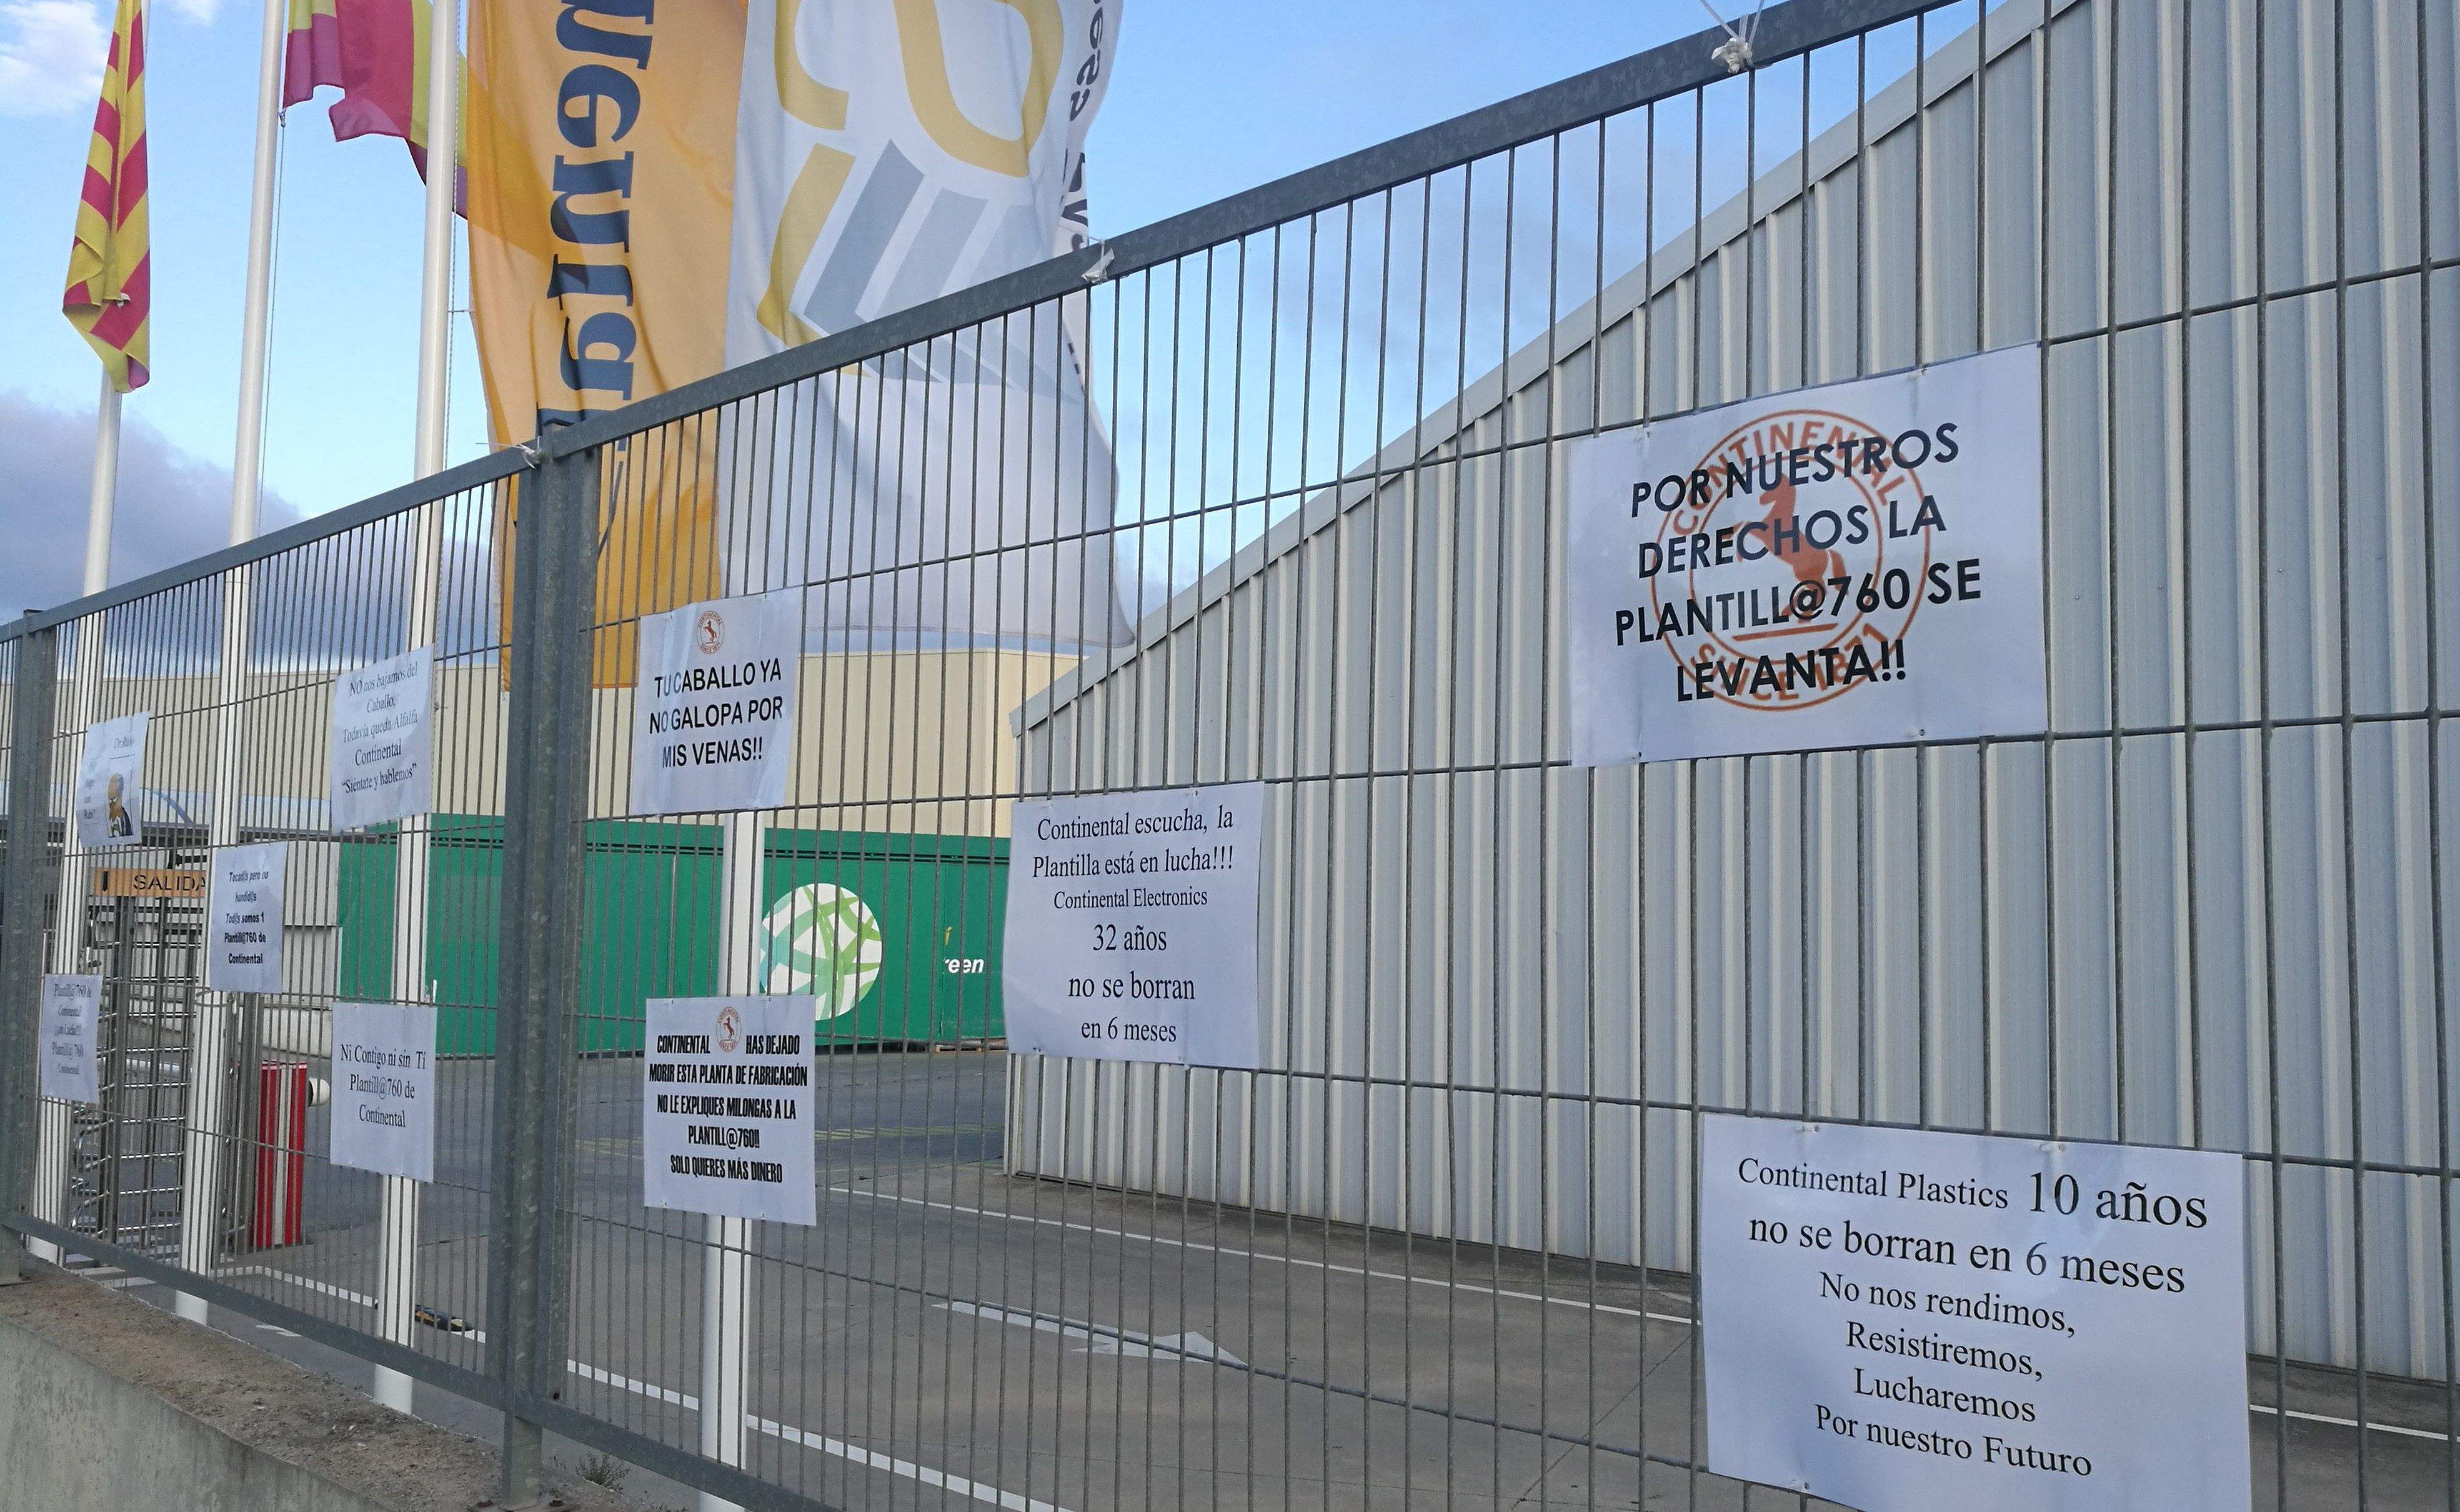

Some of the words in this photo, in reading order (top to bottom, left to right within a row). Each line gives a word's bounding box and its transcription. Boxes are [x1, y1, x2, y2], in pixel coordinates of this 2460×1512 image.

[1631, 469, 1711, 519] POR
[1726, 422, 1960, 499] NUESTROS
[1673, 420, 1905, 534] CONTINENTAL
[1638, 505, 1870, 579] DERECHOS
[1889, 494, 1946, 539] LA
[1616, 569, 1911, 647] PLANTILL@760
[1928, 559, 1982, 605] SE
[350, 680, 362, 696] NO
[364, 679, 375, 691] nos
[377, 670, 406, 688] bajamos
[407, 661, 417, 677] del
[654, 675, 671, 698] TU
[674, 662, 755, 694] CABALLO
[760, 658, 782, 683] YA
[1677, 639, 1906, 702] LEVANTA!!
[1690, 642, 1800, 702] SINCE
[367, 697, 396, 713] Caballo,
[649, 712, 669, 734] NO
[671, 702, 742, 731] GALOPA
[749, 695, 783, 721] POR
[343, 725, 369, 743] Todavía
[371, 719, 392, 738] queda
[394, 709, 418, 729] Alfalfa
[355, 739, 401, 766] Continental
[662, 745, 687, 767] MIS
[692, 737, 762, 765] VENAS!!
[374, 777, 378, 790] y
[1037, 812, 1129, 841] Continental
[1135, 807, 1208, 835] escucha,
[1218, 805, 1233, 828] la
[249, 870, 260, 881] pero
[262, 870, 269, 880] no
[1032, 854, 1100, 878] Plantilla
[1105, 852, 1135, 873] está
[1140, 855, 1158, 872] en
[1164, 845, 1234, 872] lucha!!!
[1053, 889, 1128, 909] Continental
[1133, 886, 1207, 908] Electronics
[242, 913, 259, 923] somos
[261, 912, 264, 922] 1
[224, 932, 256, 945] Plantill@760
[258, 932, 266, 943] de
[1093, 924, 1116, 952] 32
[1123, 925, 1167, 951] años
[229, 953, 263, 964] Continental
[1068, 978, 1094, 997] no
[1102, 978, 1123, 998] se
[1131, 971, 1195, 1000] borran
[1081, 1022, 1101, 1038] en
[1108, 1017, 1118, 1040] 6
[1124, 1023, 1177, 1042] meses
[341, 1045, 352, 1061] Ni
[354, 1045, 386, 1069] Contigo
[388, 1047, 396, 1066] ni
[399, 1049, 411, 1068] sin
[417, 1052, 426, 1070] Tí
[657, 1035, 710, 1054] CONTINENTAL
[746, 1035, 764, 1054] HAS
[766, 1035, 800, 1055] DEJADO
[349, 1074, 402, 1100] Plantill@760
[405, 1081, 415, 1098] de
[649, 1065, 674, 1083] MORIR
[677, 1064, 697, 1083] ESTA
[700, 1065, 733, 1084] PLANTA
[735, 1065, 746, 1084] DE
[749, 1063, 807, 1087] FABRICACIÓN
[359, 1105, 406, 1127] Continental
[657, 1095, 667, 1113] NO
[670, 1097, 679, 1114] LE
[681, 1097, 724, 1117] EXPLIQUES
[726, 1098, 772, 1118] MILONGAS
[774, 1099, 781, 1118] A
[784, 1100, 796, 1119] LA
[688, 1125, 760, 1149] PLANTILL@760!!
[670, 1155, 689, 1173] SOLO
[692, 1157, 725, 1179] QUIERES
[728, 1158, 749, 1180] MÁS
[751, 1161, 783, 1183] DINERO
[1738, 1157, 1887, 1198] Continental
[1898, 1172, 2009, 1209] Plastics
[2029, 1171, 2080, 1215] 10
[2095, 1181, 2209, 1228] años
[1748, 1217, 1788, 1244] no
[1799, 1223, 1831, 1249] se
[1844, 1221, 1956, 1266] borran
[1969, 1243, 2011, 1273] en
[2026, 1241, 2047, 1276] 6
[2060, 1255, 2186, 1294] meses
[1820, 1271, 1860, 1302] No
[1868, 1285, 1917, 1310] nos
[1925, 1291, 2075, 1336] rendimos,
[1846, 1321, 2043, 1380] Resistiremos,
[1854, 1368, 2036, 1422] Lucharemos
[1815, 1404, 1858, 1439] Por
[1866, 1421, 1973, 1459] nuestro
[1983, 1436, 2093, 1476] Futuro
